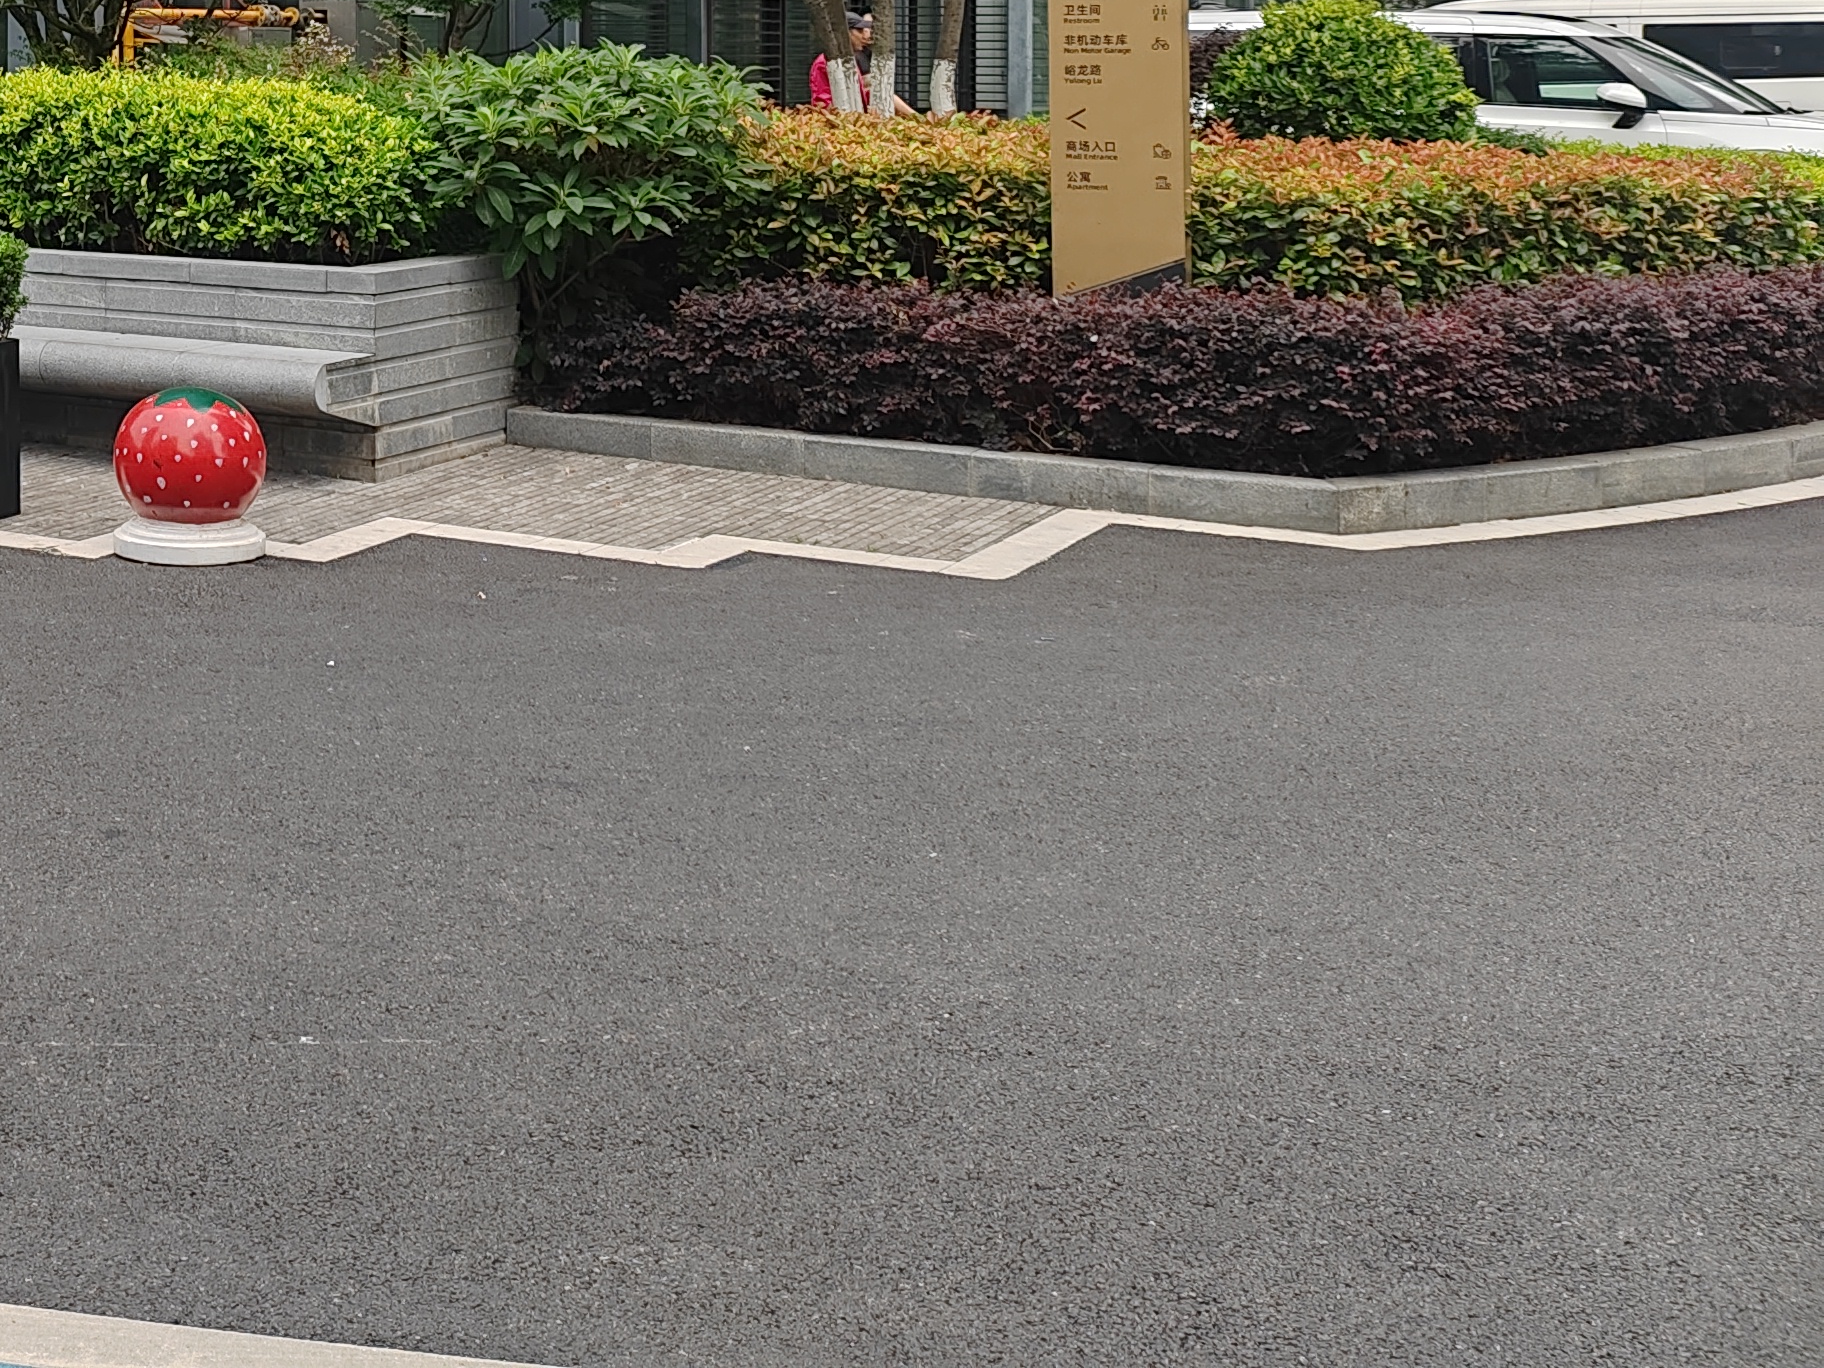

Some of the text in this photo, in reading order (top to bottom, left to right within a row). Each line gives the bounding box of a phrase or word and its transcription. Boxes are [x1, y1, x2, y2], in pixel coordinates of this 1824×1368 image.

[1063, 4, 1101, 16] 卫生间
[1063, 34, 1128, 46] 非机动车库
[1104, 47, 1132, 55] Garage
[1064, 64, 1102, 77] 峪龙路
[1064, 77, 1092, 85] Yulong
[1065, 140, 1116, 152] 商场入口
[1066, 171, 1091, 183] 公寓
[1066, 183, 1109, 191] Apartment
